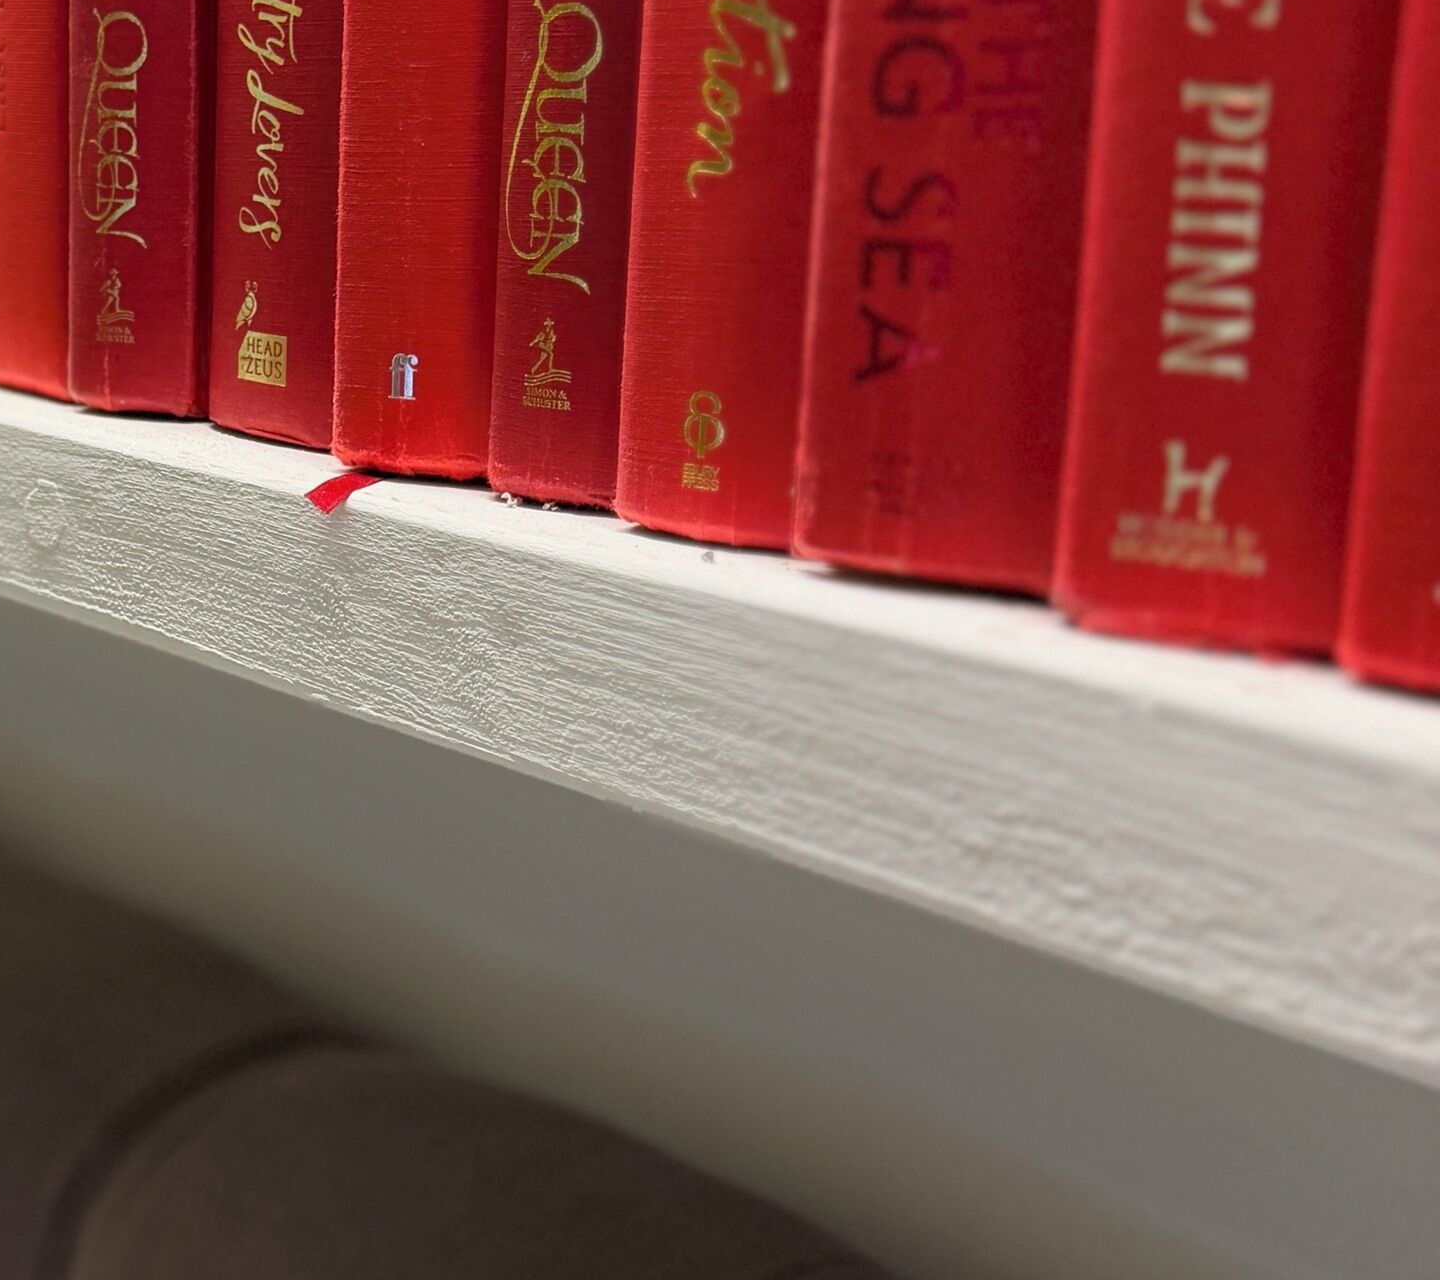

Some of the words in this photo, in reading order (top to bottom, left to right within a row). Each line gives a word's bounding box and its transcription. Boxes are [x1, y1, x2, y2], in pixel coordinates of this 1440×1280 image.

[238, 65, 305, 250] Lovers
[1160, 80, 1272, 383] PHINN
[852, 166, 958, 382] SEA
[246, 336, 283, 358] HEAD
[241, 356, 283, 379] ZEUS
[522, 396, 571, 411] SCHUSTER
[526, 387, 557, 399] SIMON
